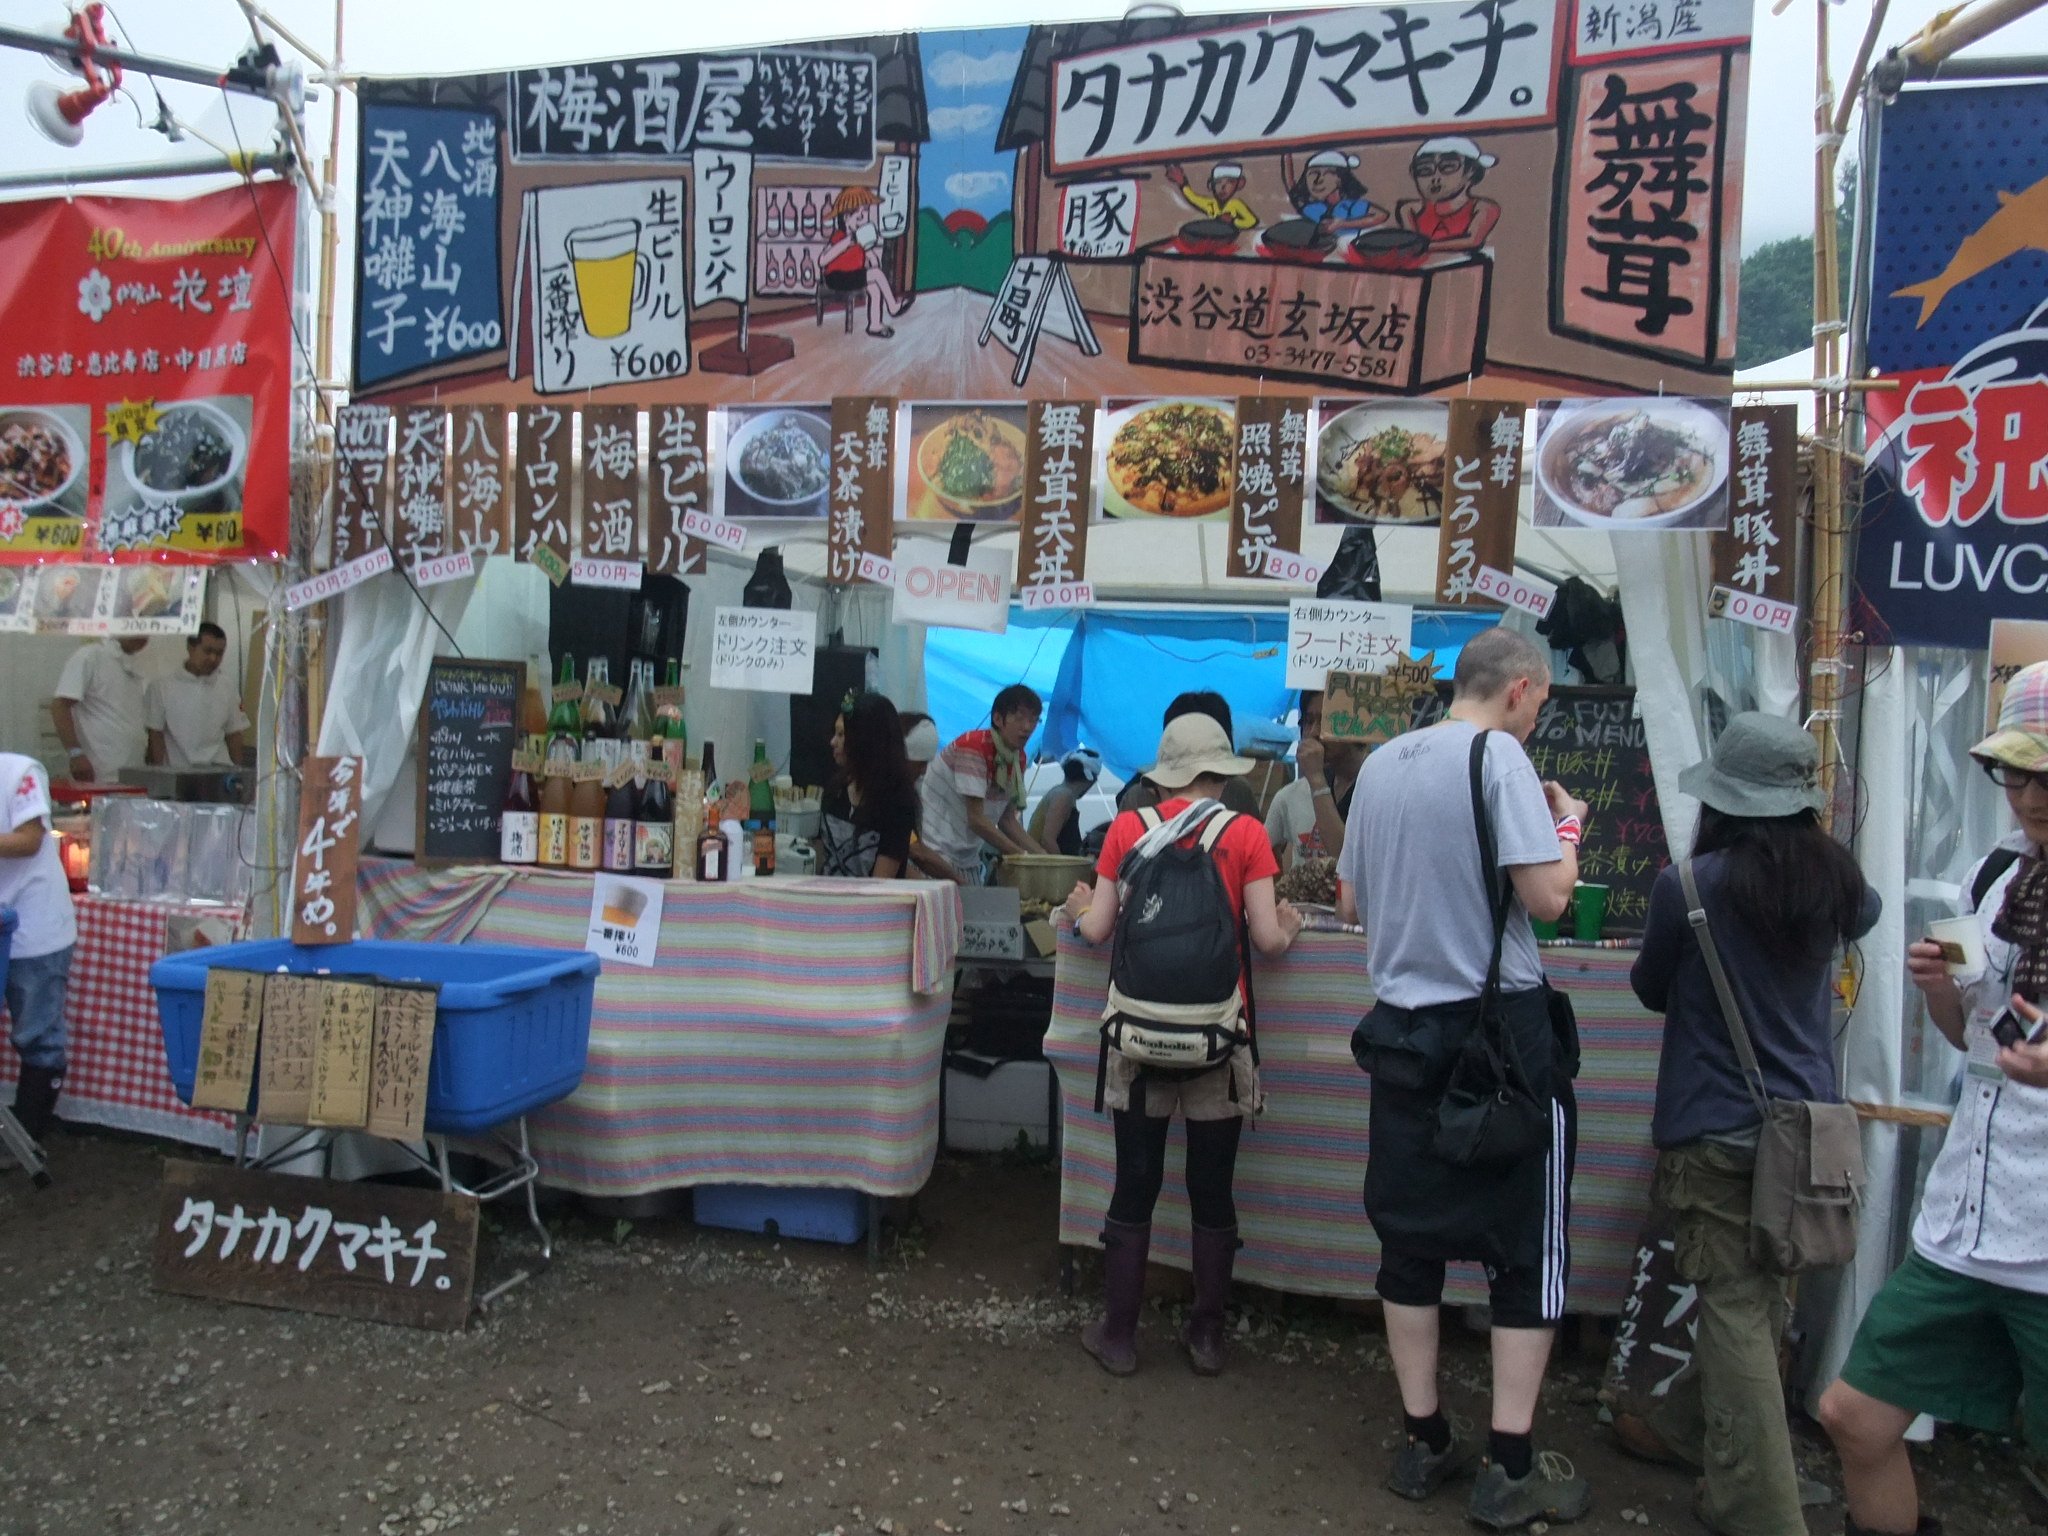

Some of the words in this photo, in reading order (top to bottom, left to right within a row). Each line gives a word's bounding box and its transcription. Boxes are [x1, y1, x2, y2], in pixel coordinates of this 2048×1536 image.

[1585, 1, 1702, 46] 新潟産
[527, 60, 755, 154] 梅酒屋
[776, 58, 795, 125] いちご
[813, 60, 833, 117] ゆず
[852, 65, 872, 137] マンゴー
[1061, 1, 1537, 157] タナカクマキチ。
[462, 118, 497, 197] 地酒
[887, 160, 902, 211] コーヒー
[420, 140, 467, 296] 八海山
[703, 157, 738, 296] ウーロンハイ
[1066, 185, 1130, 239] 豚
[1581, 73, 1712, 335] 舞茸
[149, 237, 256, 259] Anniversary
[646, 188, 680, 321] 生ビール
[425, 305, 501, 358] ¥600
[541, 264, 580, 385] 一番搾り
[999, 262, 1041, 343] 十日町
[1139, 279, 1410, 353] 渋谷道玄坂店
[611, 344, 682, 378] ¥600
[1244, 345, 1395, 379] 03-3477-5581
[340, 417, 386, 446] HOT
[865, 403, 889, 470] 舞茸
[1278, 408, 1306, 485] 舞茸
[1490, 411, 1523, 487] 舞茸
[1902, 380, 2048, 526] 祝
[361, 463, 383, 549] コーヒー
[459, 411, 501, 555] 八海山
[588, 424, 636, 554] 梅酒
[658, 409, 705, 574] 生ビール
[832, 432, 864, 580] 天茶漬け
[1034, 403, 1086, 586] 舞茸天丼
[1237, 423, 1281, 575] 照焼ピザ
[1732, 421, 1780, 595] 舞茸豚丼
[686, 514, 743, 543] 600円
[1443, 457, 1481, 604] とろろ丼
[419, 553, 471, 580] 600円
[863, 558, 895, 580] 60
[905, 566, 999, 604] OPEN
[1027, 586, 1090, 606] 700円
[1478, 573, 1548, 613] 500円
[1890, 542, 2048, 591] LUVC
[718, 614, 792, 629] 左側カウンター
[1294, 606, 1386, 623] 右側カウンター
[1714, 591, 1792, 628] 500円
[717, 633, 808, 657] ドリンク注文
[1295, 631, 1402, 657] フード注文
[1394, 664, 1430, 685] ¥500
[436, 680, 469, 695] DRINK
[1530, 745, 1620, 780] 茸豚丼
[1575, 722, 1647, 749] MENU
[328, 757, 359, 840] 今年で
[301, 817, 337, 937] 4年め。
[615, 943, 639, 958] ¥600
[174, 1197, 450, 1289] タナカクマキチ。
